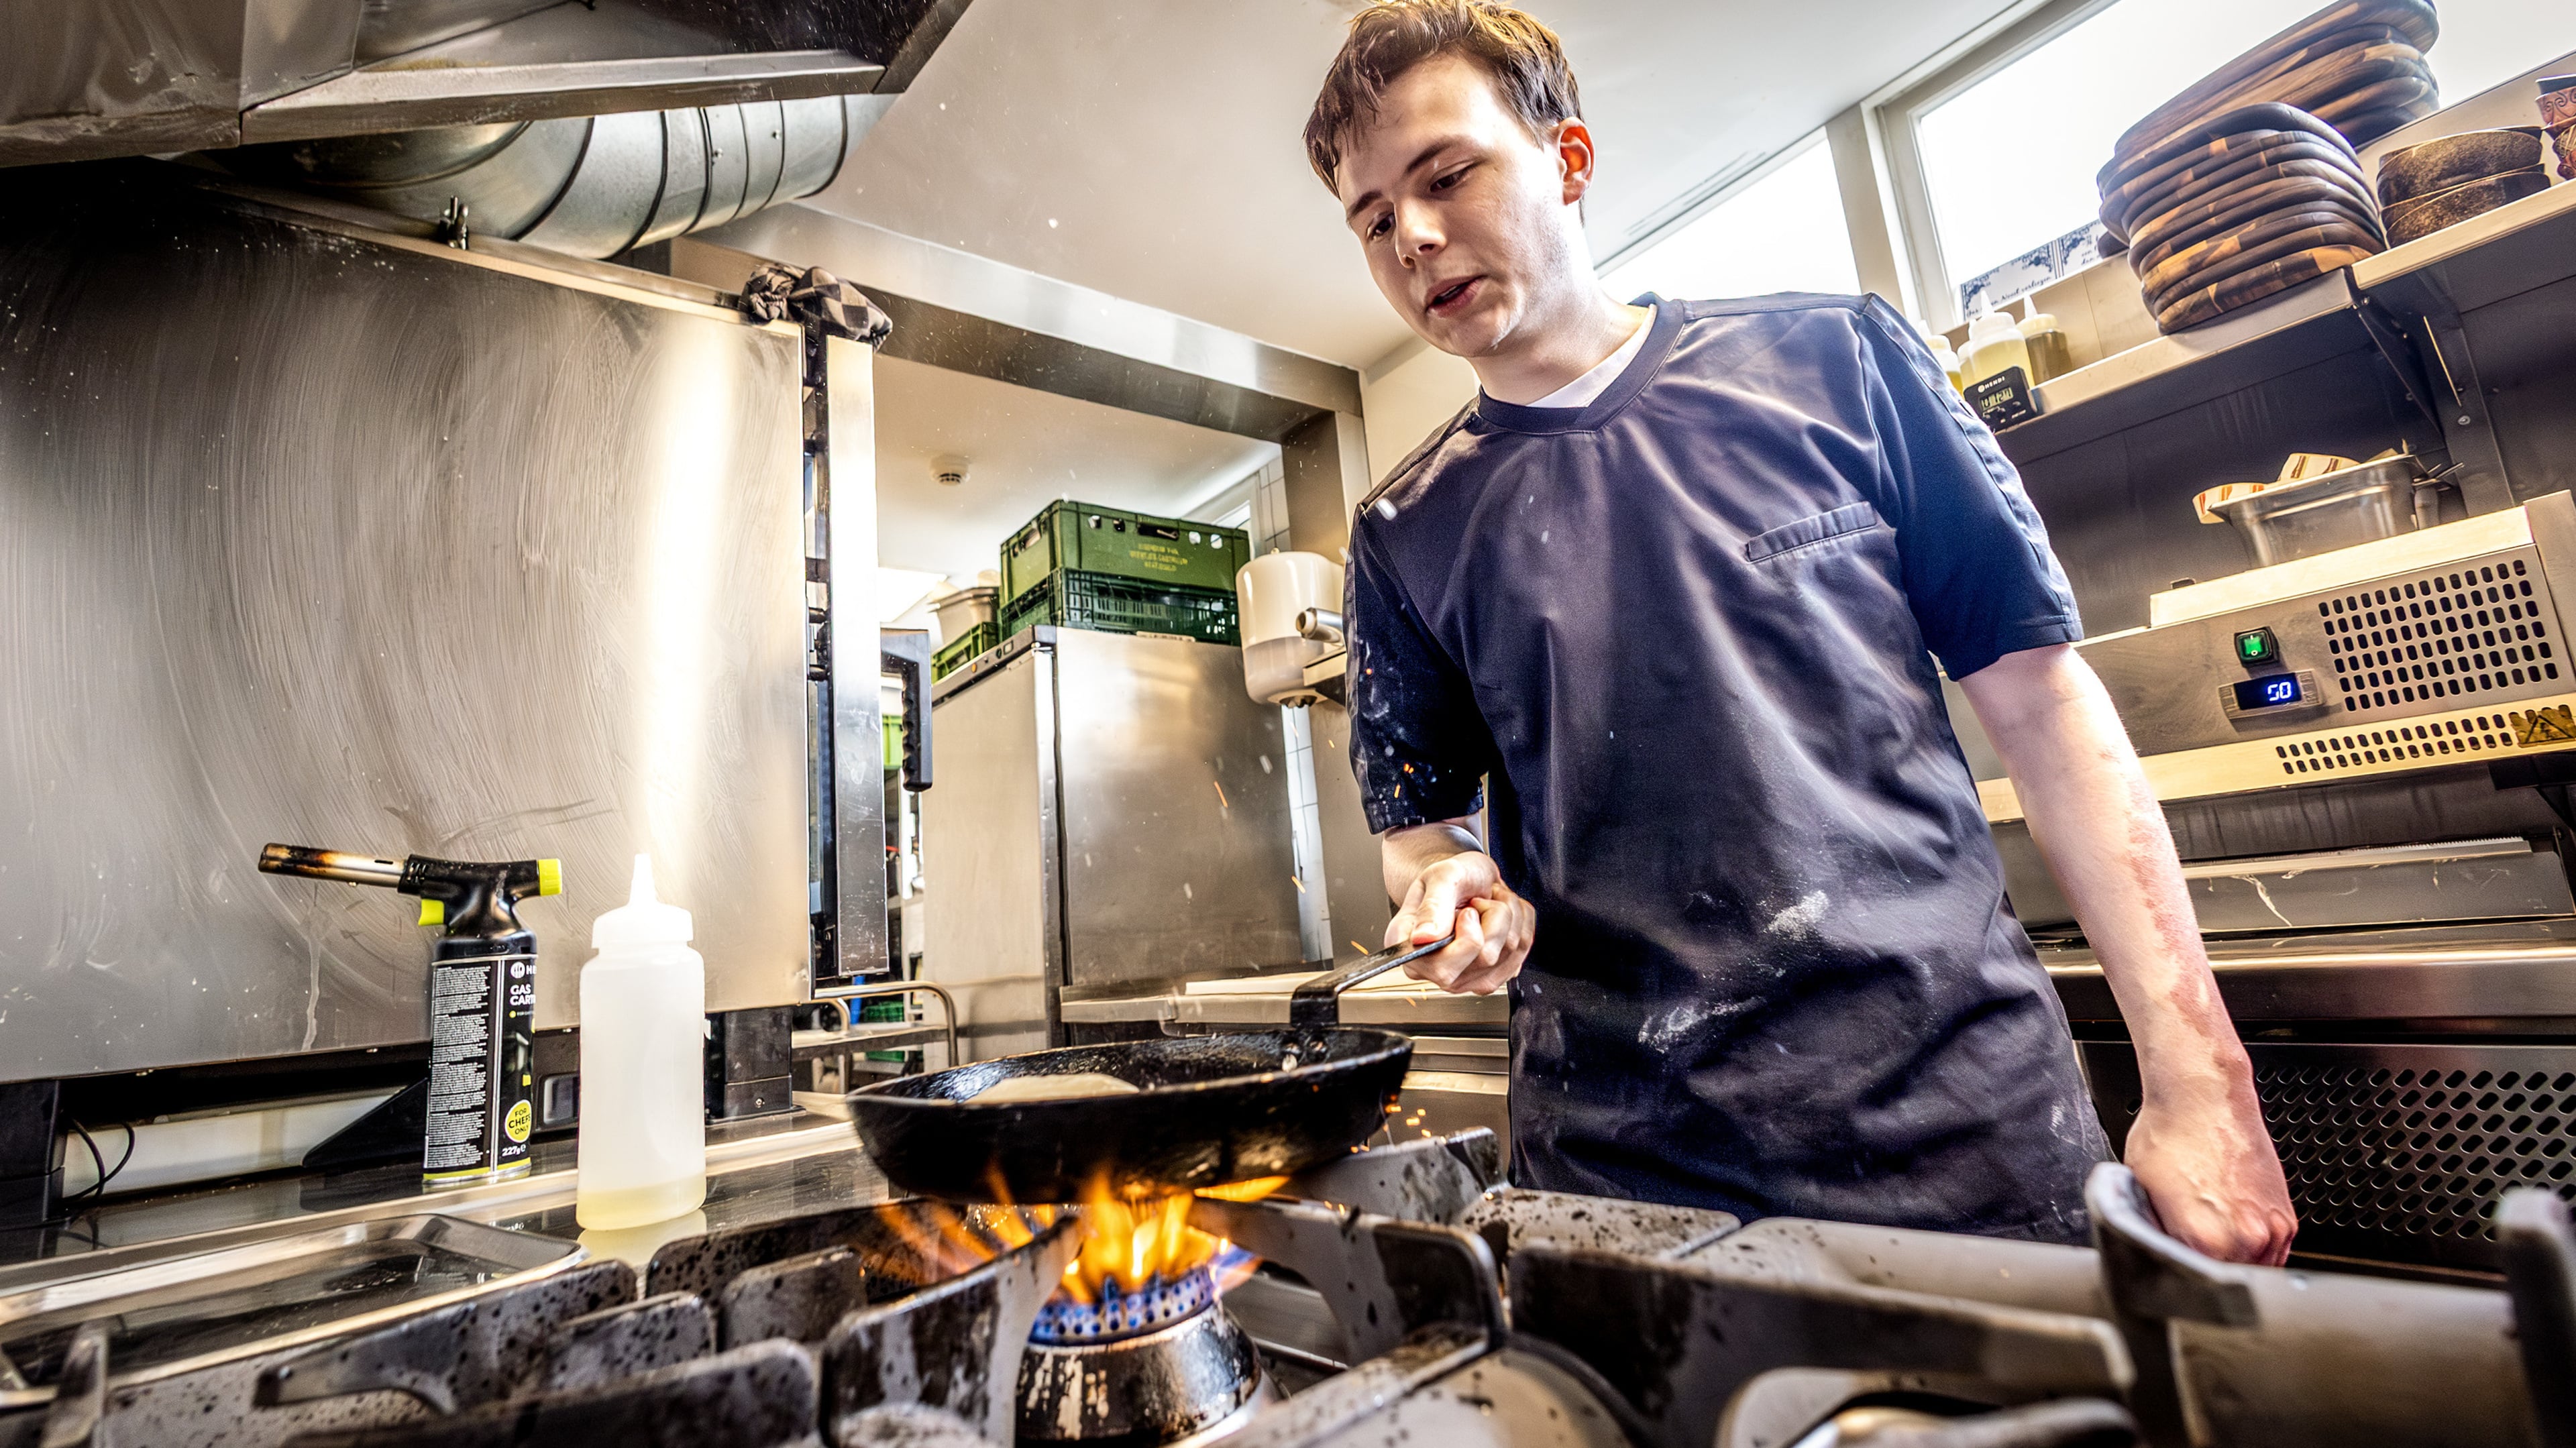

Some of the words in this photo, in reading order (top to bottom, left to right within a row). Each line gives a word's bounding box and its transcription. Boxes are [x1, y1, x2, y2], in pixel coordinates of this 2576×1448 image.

[2267, 681, 2292, 701] 50
[510, 984, 531, 995] GAS
[515, 1107, 527, 1117] FOR
